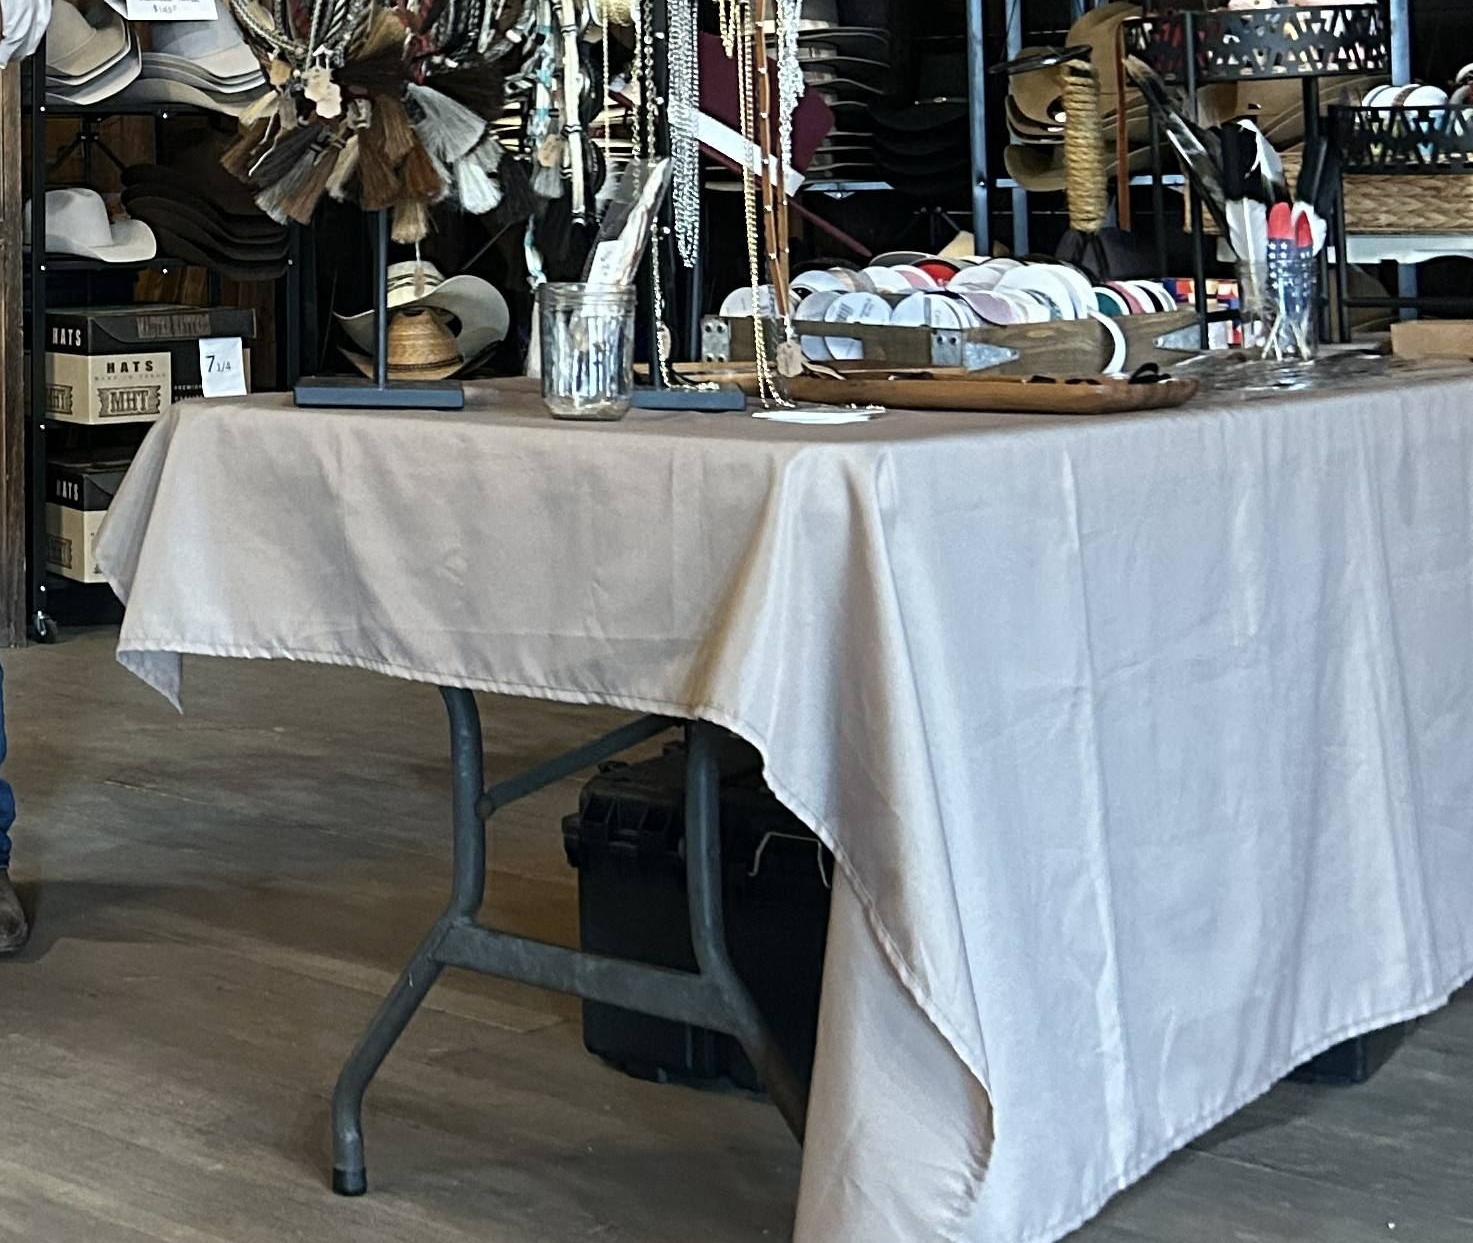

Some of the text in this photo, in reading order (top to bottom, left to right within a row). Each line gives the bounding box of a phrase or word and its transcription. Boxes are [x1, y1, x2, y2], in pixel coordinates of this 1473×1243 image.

[52, 327, 82, 347] HATS
[106, 361, 154, 374] HATS
[205, 355, 216, 373] 7
[110, 389, 149, 413] MHT
